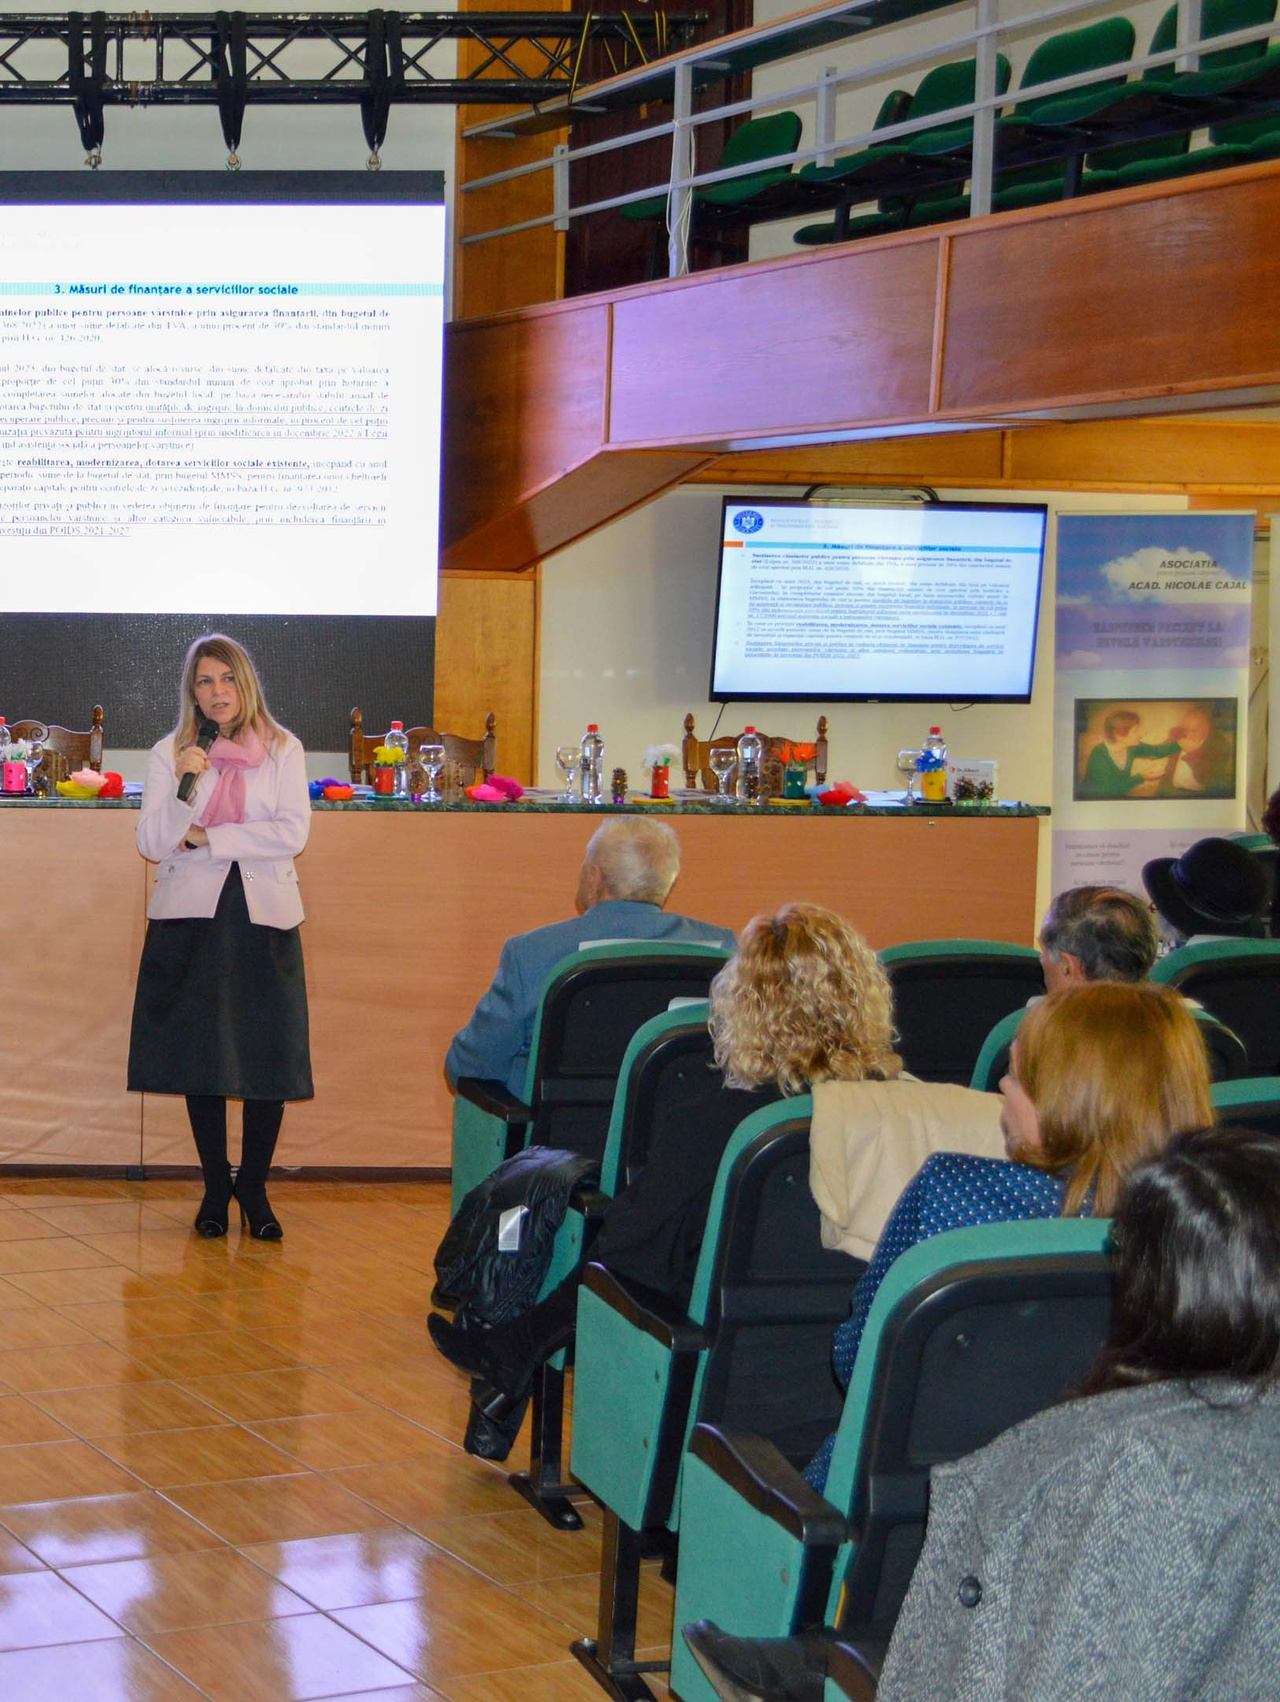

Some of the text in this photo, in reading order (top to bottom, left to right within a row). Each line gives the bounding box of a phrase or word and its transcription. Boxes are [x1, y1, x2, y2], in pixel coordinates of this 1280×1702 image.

[54, 284, 298, 297] 3. Măsuri de finanțare a serviciilor sociale
[1160, 560, 1218, 568] ASOCIATIA
[1128, 582, 1247, 590] ACAD. NICOLAE CAJAL
